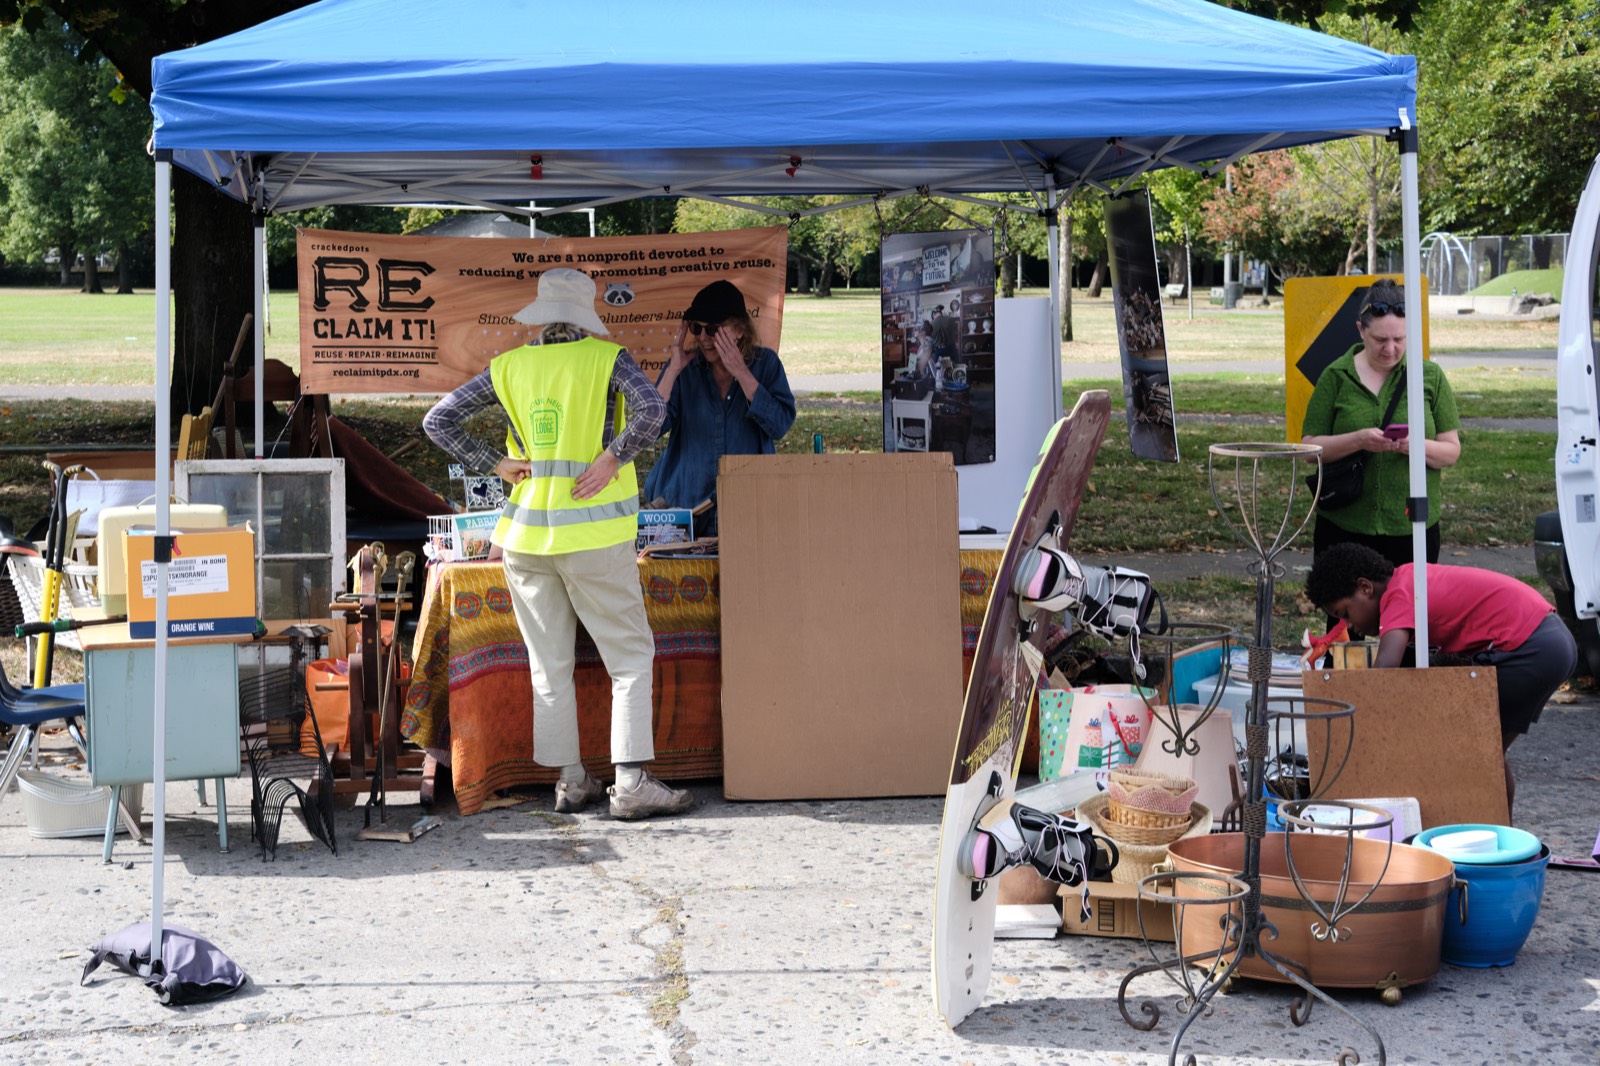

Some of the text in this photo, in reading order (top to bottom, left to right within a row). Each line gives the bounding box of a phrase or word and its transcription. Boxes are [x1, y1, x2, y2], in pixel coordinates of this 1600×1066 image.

[311, 244, 370, 253] crackedpots
[925, 248, 947, 259] WELCOME
[512, 246, 725, 264] We are a nonprofit devoted to
[459, 267, 524, 280] reducing
[590, 265, 667, 279] promoting
[670, 260, 730, 273] creative
[733, 257, 776, 269] reuse.
[926, 270, 946, 280] FUTURE
[312, 256, 436, 313] RE
[600, 309, 663, 324] olunteers
[313, 318, 436, 341] CLAIM IT!
[315, 350, 437, 360] REUSE REPAIR REIMAGINE
[333, 368, 420, 378] reclaimitpdx.org
[643, 513, 676, 523] WOOD
[171, 622, 215, 633] ORANGE WINE
